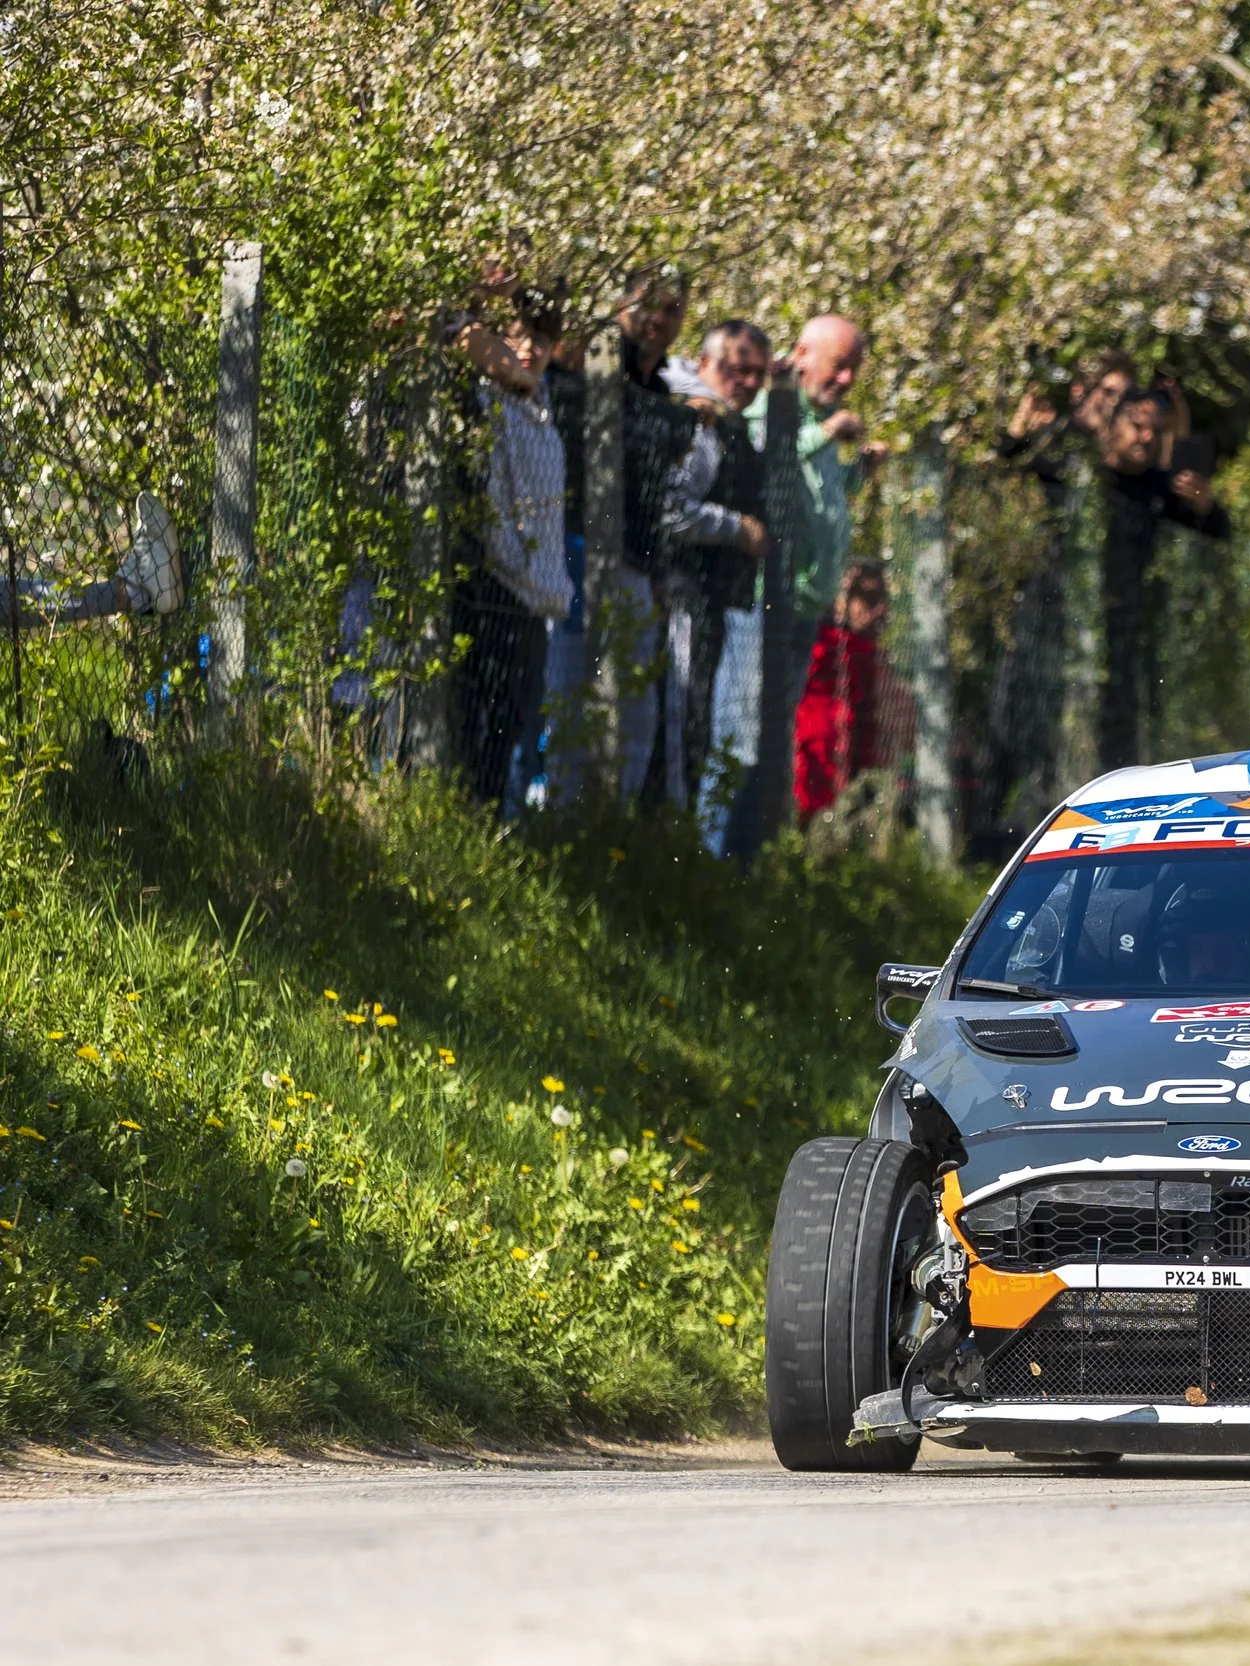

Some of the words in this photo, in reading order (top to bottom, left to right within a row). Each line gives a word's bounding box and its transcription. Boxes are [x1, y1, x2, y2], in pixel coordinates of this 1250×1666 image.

[1188, 1136, 1231, 1150] Ford
[1165, 1271, 1206, 1286] PX24
[1212, 1272, 1242, 1286] BWL
